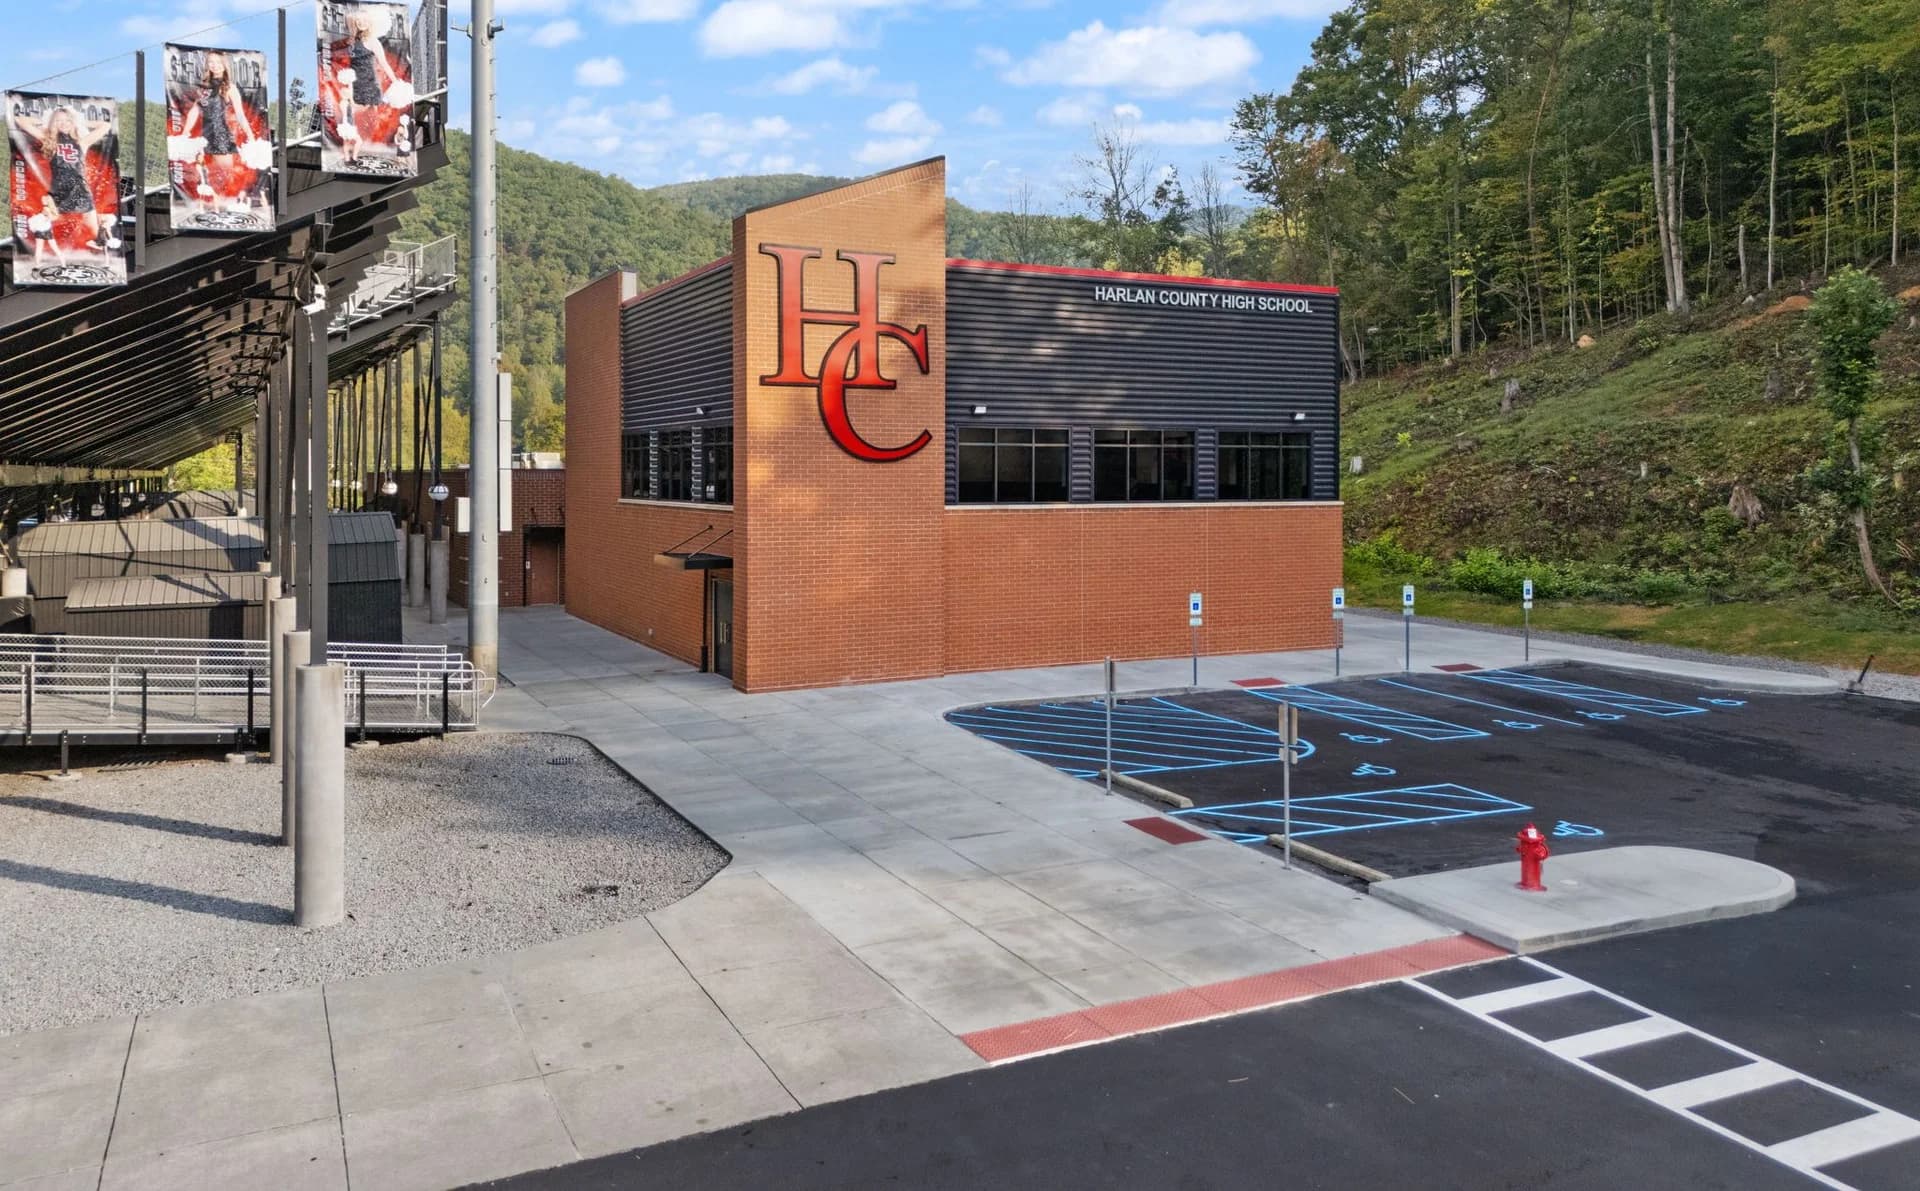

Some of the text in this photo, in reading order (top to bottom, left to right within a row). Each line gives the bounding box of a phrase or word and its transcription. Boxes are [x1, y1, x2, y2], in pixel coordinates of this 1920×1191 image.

[758, 243, 933, 463] HC
[1095, 286, 1313, 313] HARLAN COUNTY HIGH SCHOOL
